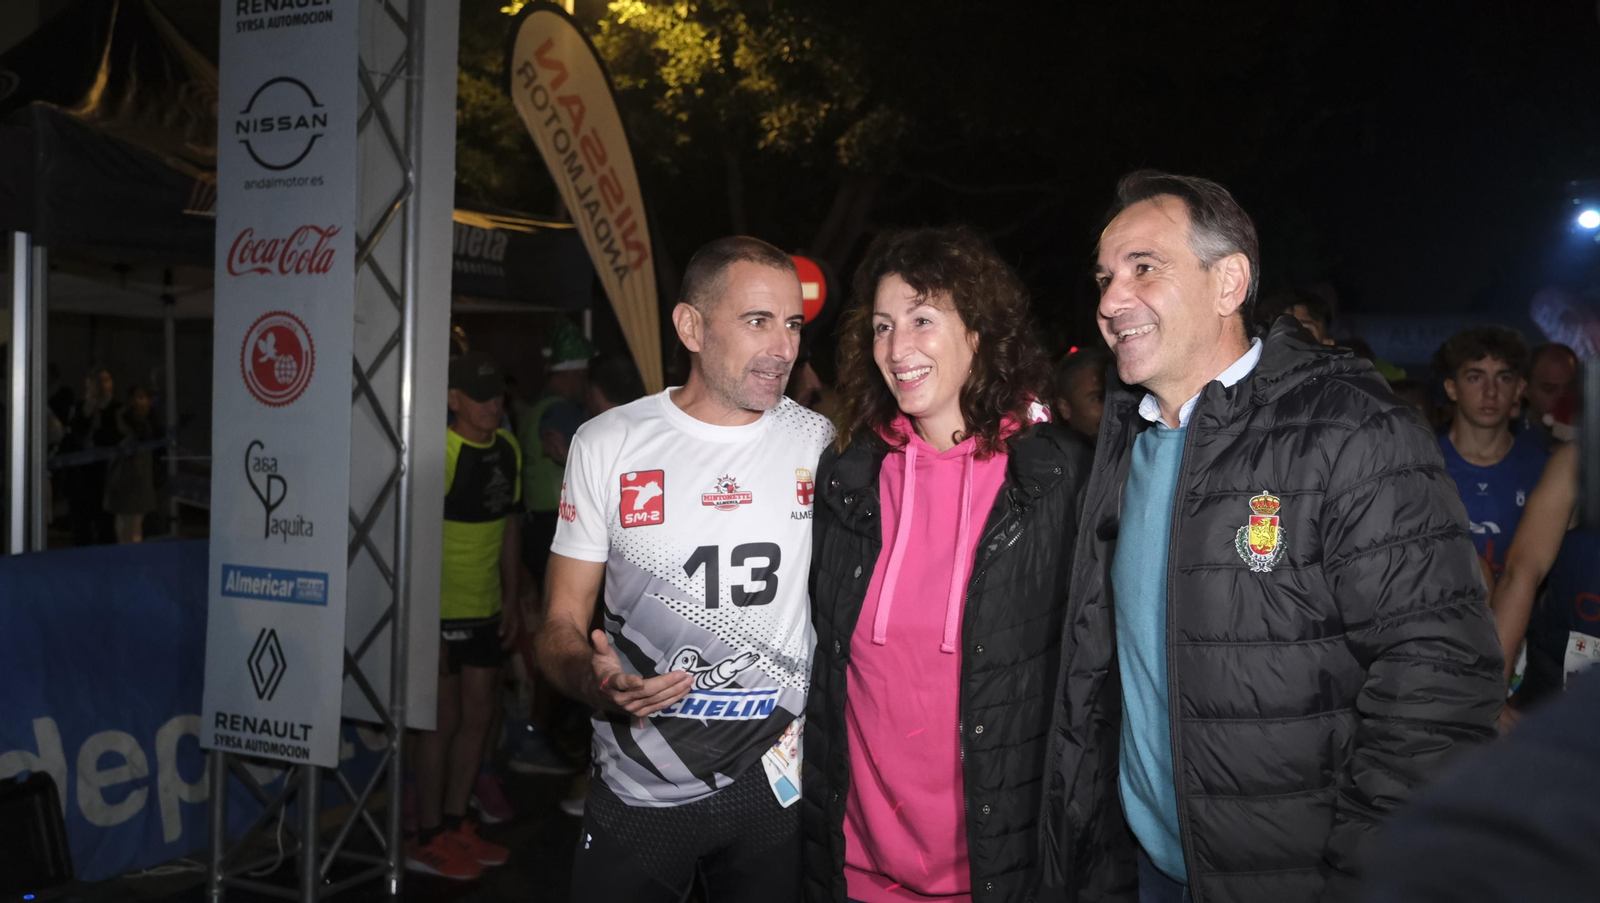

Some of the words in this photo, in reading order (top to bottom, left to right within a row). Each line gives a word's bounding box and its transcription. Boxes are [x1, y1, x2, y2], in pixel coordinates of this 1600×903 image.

[236, 18, 264, 33] SYRSA
[267, 10, 333, 29] AUTOMOCION
[235, 113, 327, 134] NISSAN
[244, 176, 324, 190] andalmotor.es
[703, 492, 752, 502] MINTONETTE
[265, 474, 314, 544] Paquita
[625, 510, 660, 524] SM-2
[225, 570, 296, 598] Almericar
[683, 542, 781, 609] 13
[660, 698, 775, 717] CHELIN
[215, 711, 313, 742] RENAULT
[214, 733, 243, 750] SYRSA
[245, 739, 310, 760] AUTOMOCION
